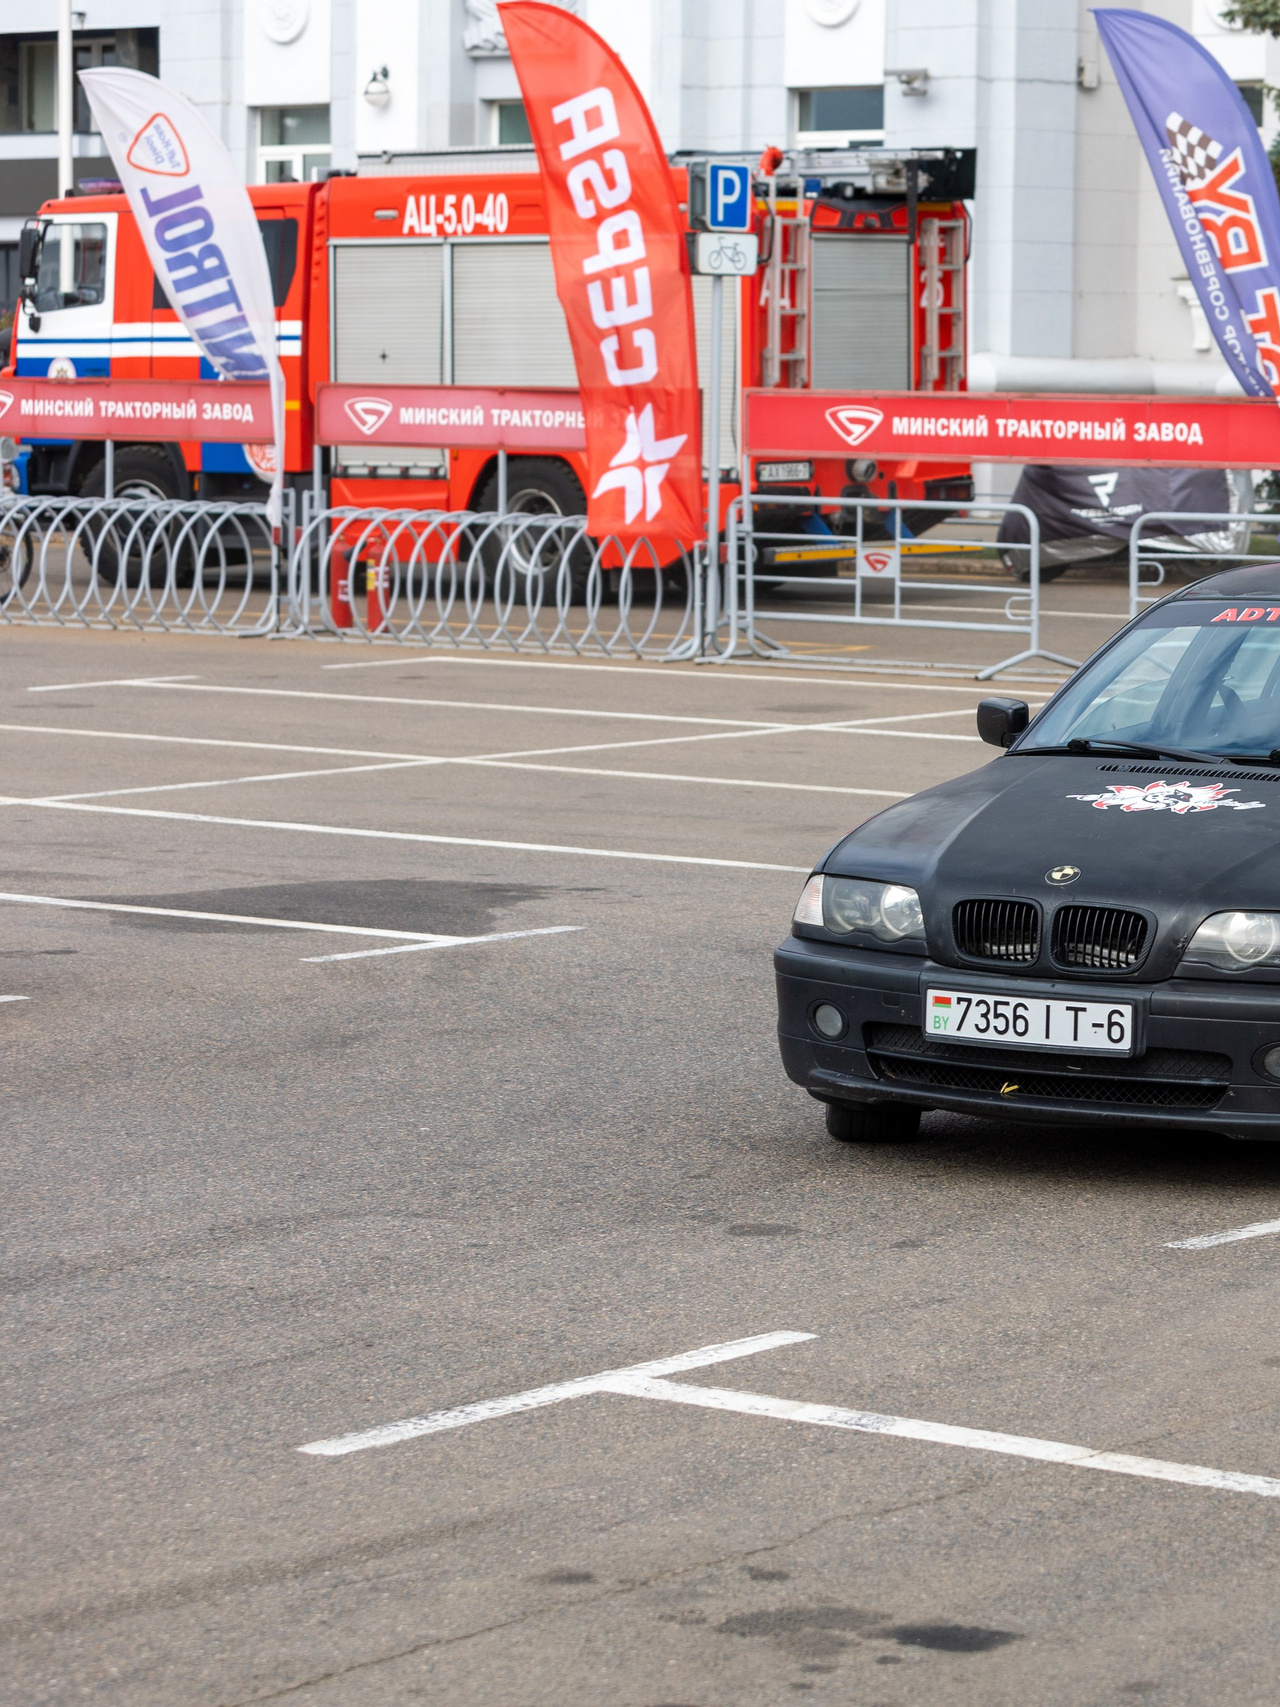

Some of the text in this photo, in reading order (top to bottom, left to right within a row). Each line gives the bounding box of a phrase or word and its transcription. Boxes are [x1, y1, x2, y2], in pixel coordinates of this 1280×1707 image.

[717, 170, 742, 222] P
[402, 193, 509, 237] АЦ-5,0-40
[20, 397, 254, 422] МИНСКИЙ ТРАКТОРНЫЙ ЗАВОД
[399, 404, 484, 426] МИНСКИЙ
[892, 414, 1203, 445] МИНСКИЙ ТРАКТОРНЫЙ ЗАВОД
[933, 1015, 950, 1030] BY
[956, 996, 1029, 1037] 7356
